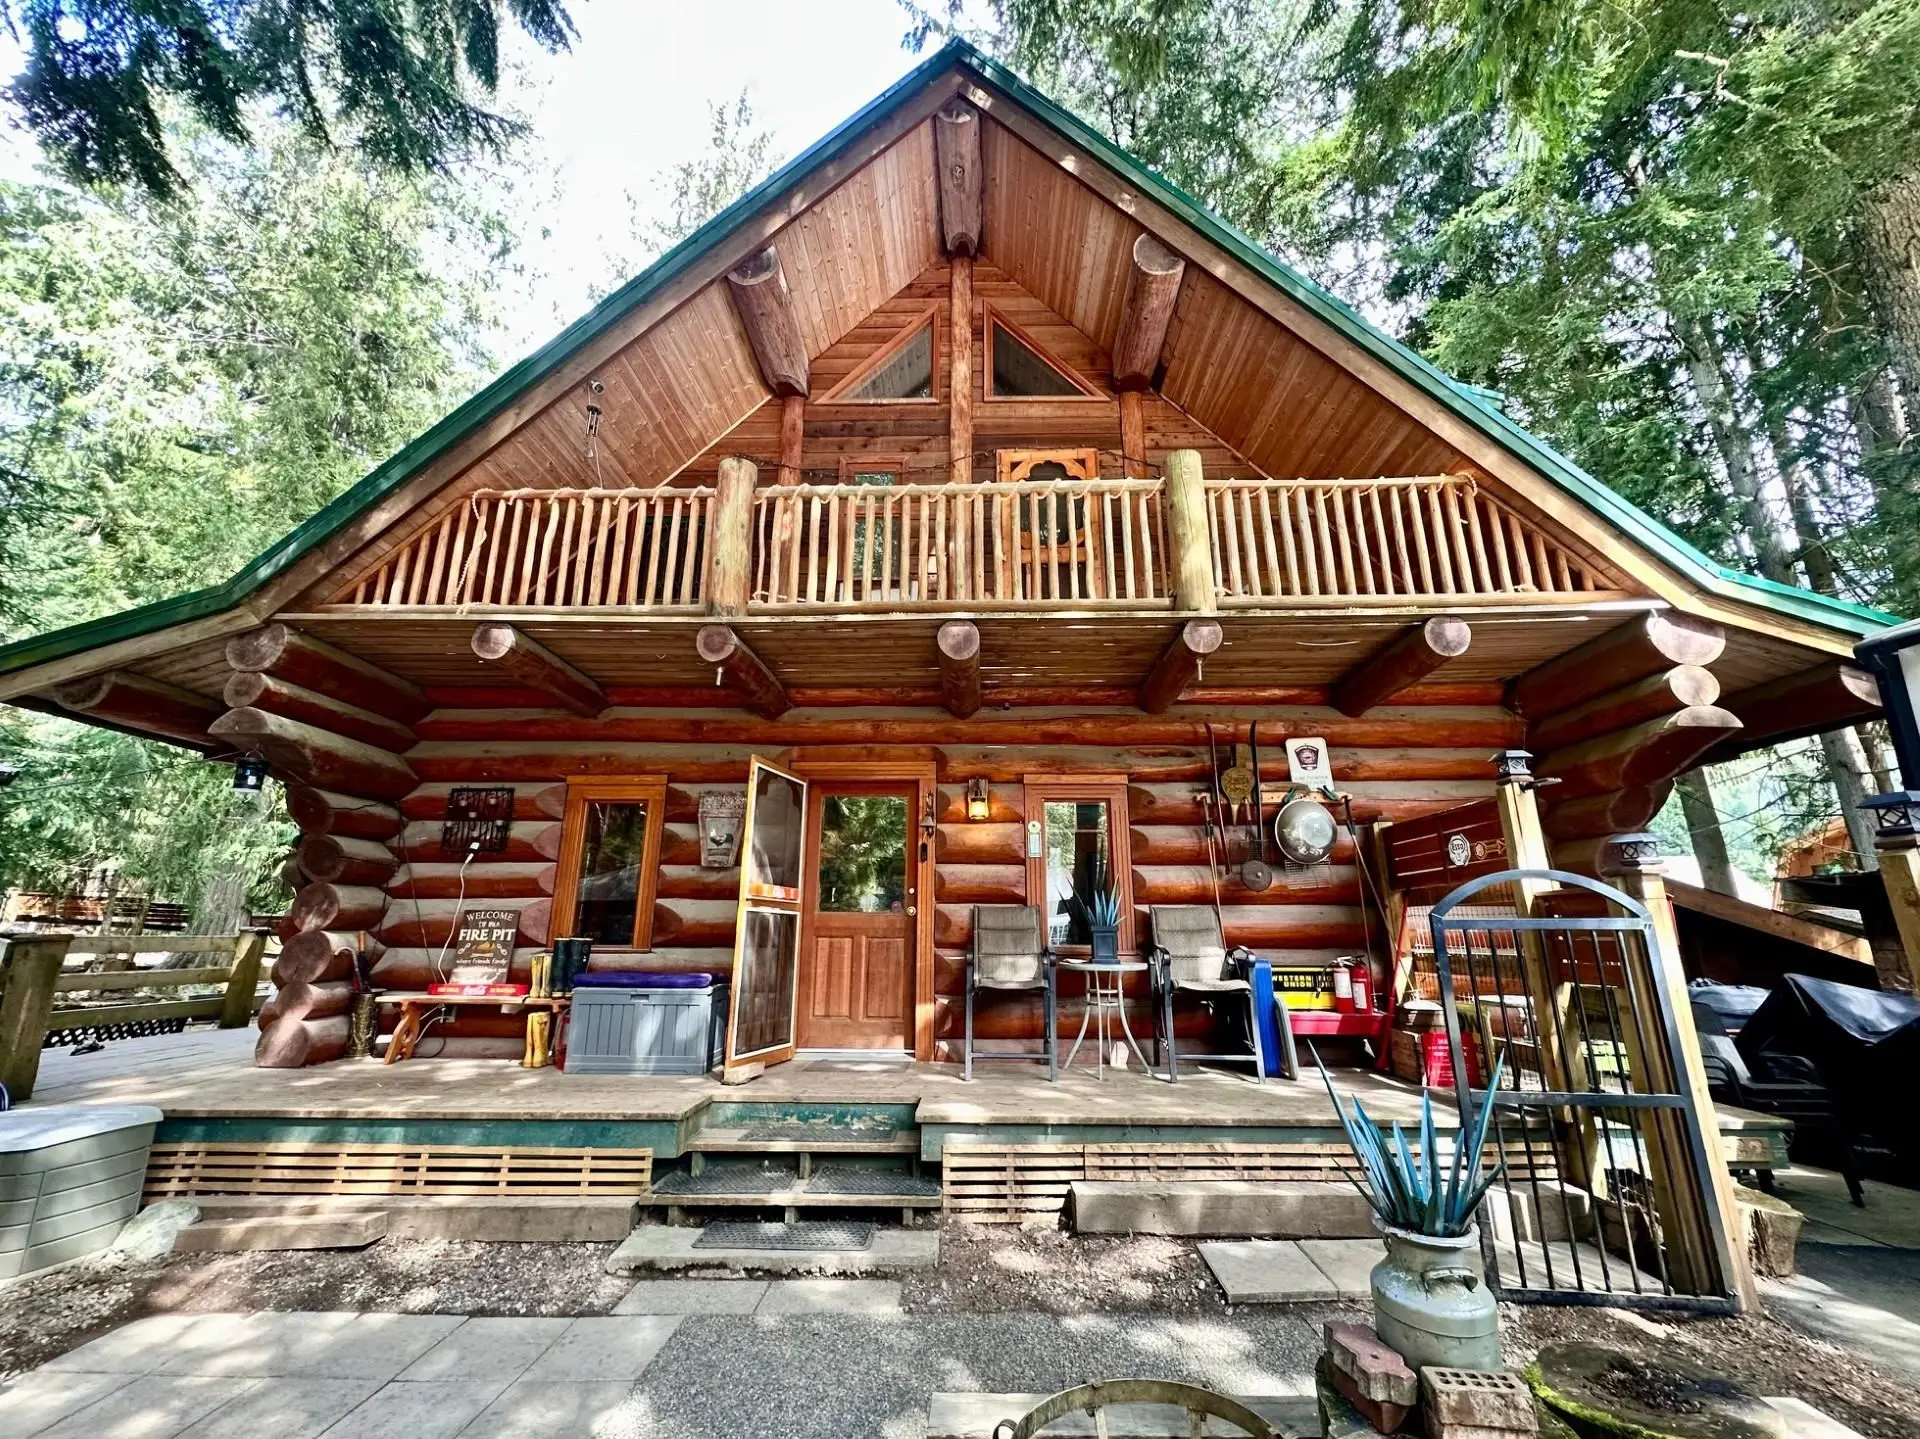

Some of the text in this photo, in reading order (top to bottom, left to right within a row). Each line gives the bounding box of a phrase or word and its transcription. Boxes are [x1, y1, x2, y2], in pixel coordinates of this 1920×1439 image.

[466, 911, 515, 921] WELCOME
[459, 929, 516, 941] FIRE PIT
